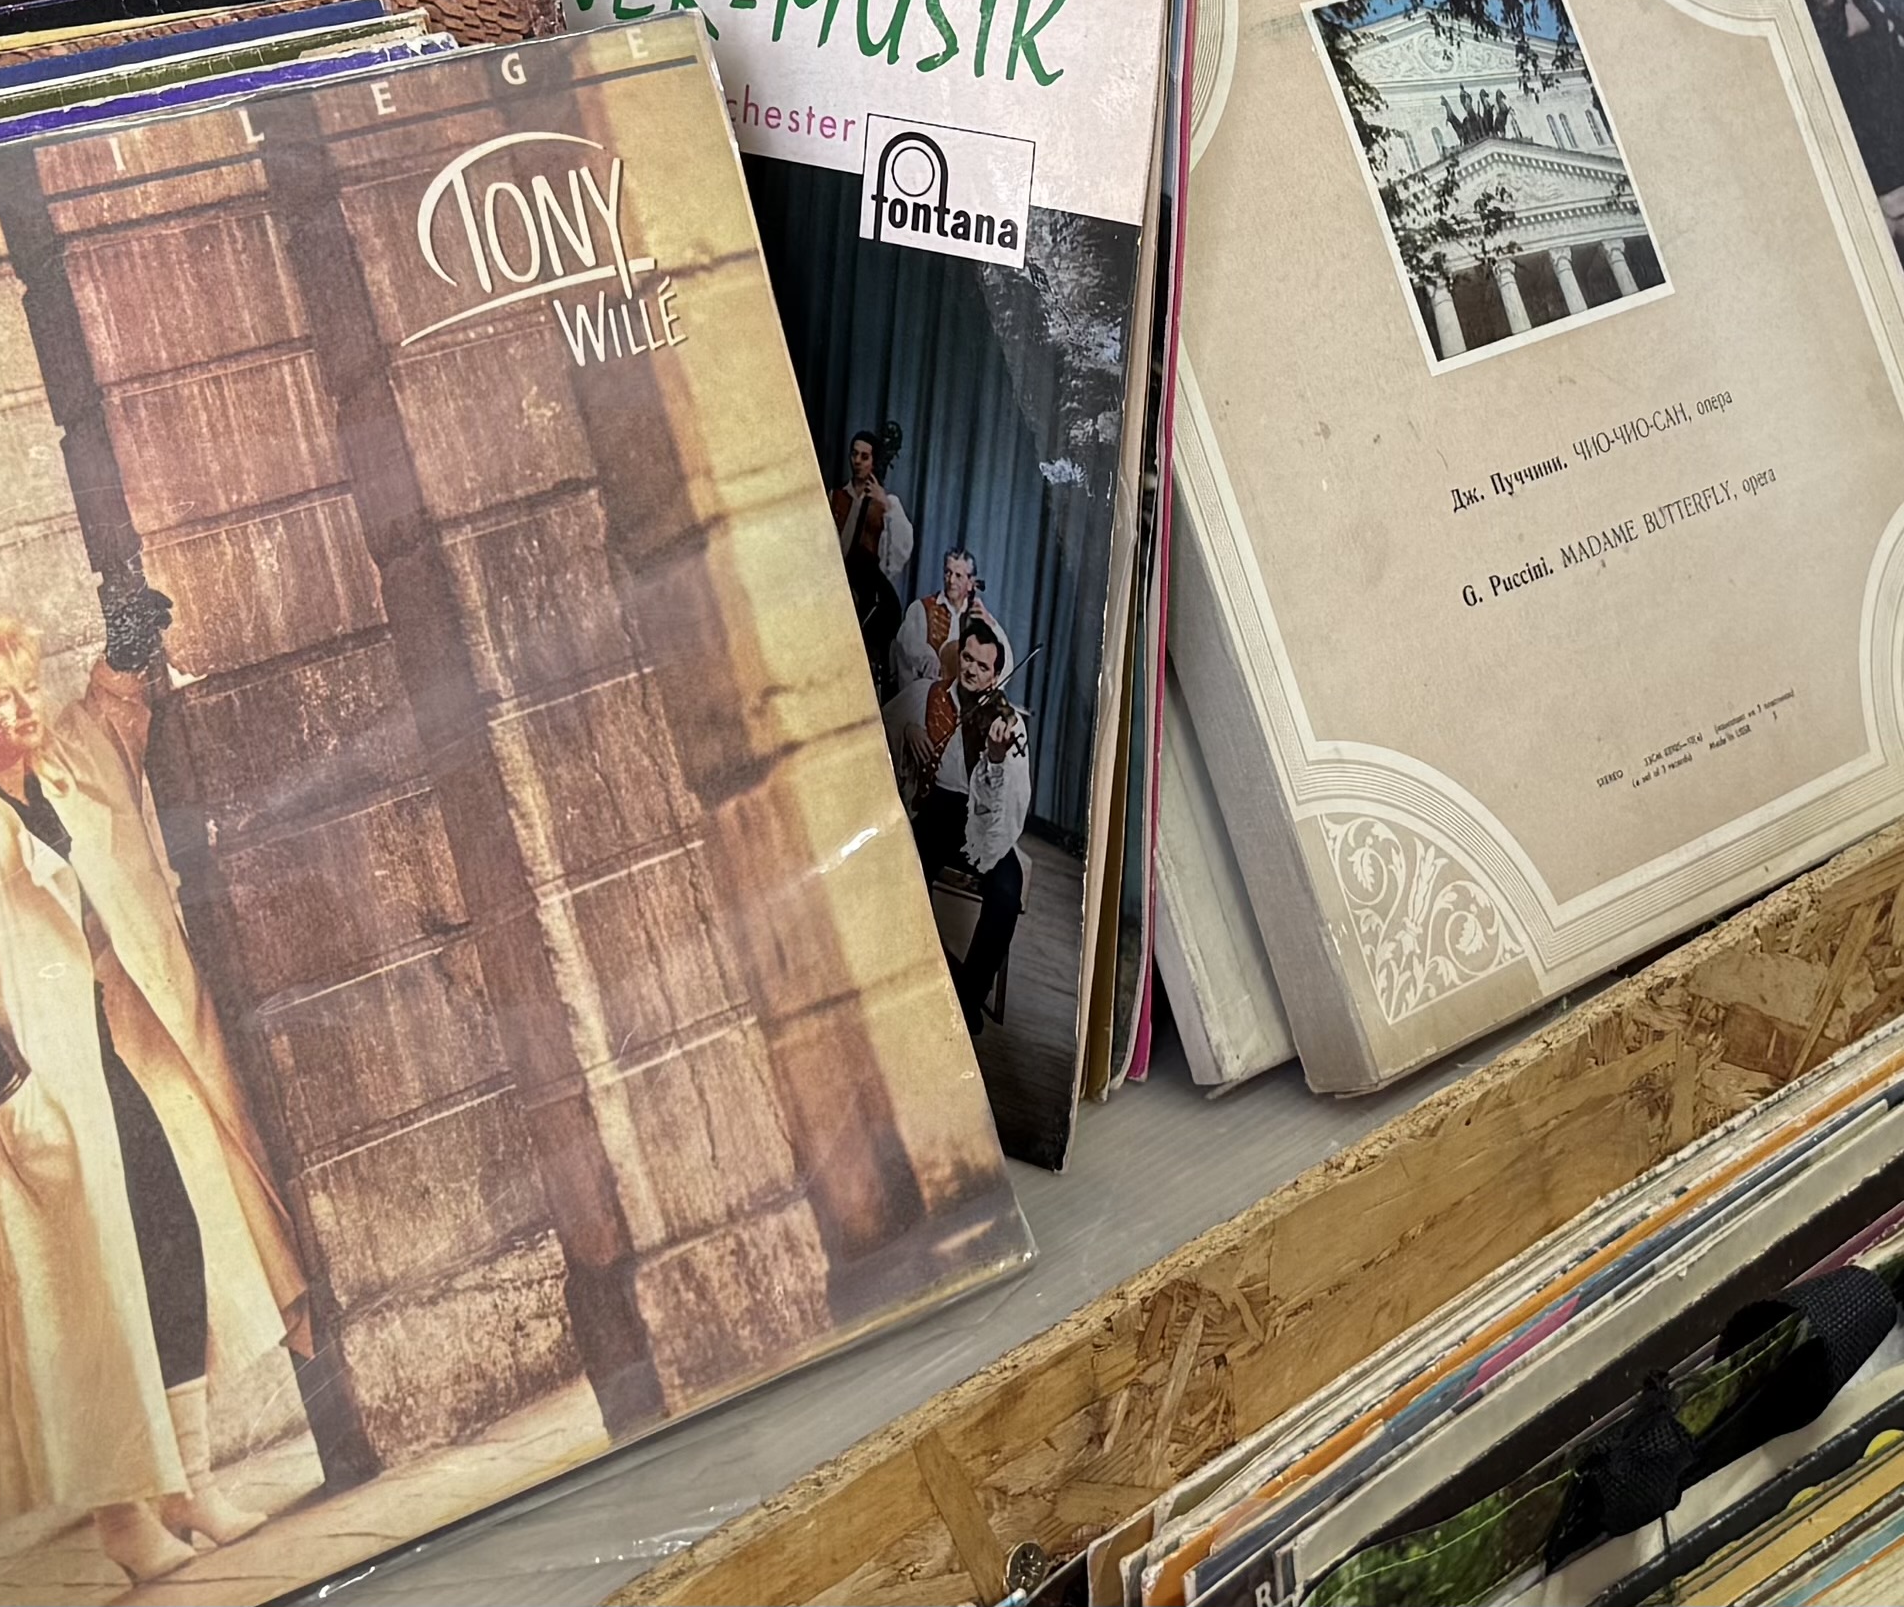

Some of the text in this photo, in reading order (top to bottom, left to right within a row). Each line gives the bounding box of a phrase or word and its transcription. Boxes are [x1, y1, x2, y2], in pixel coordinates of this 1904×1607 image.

[728, 81, 856, 144] chester
[416, 132, 656, 297] TONY
[871, 179, 1020, 252] fontana
[1449, 390, 1734, 515] Дж. Пуччини. ЧИО-ЧИО-САН, опера
[1462, 466, 1777, 610] G. Puccini. MADAME BUTTERFLY, opera
